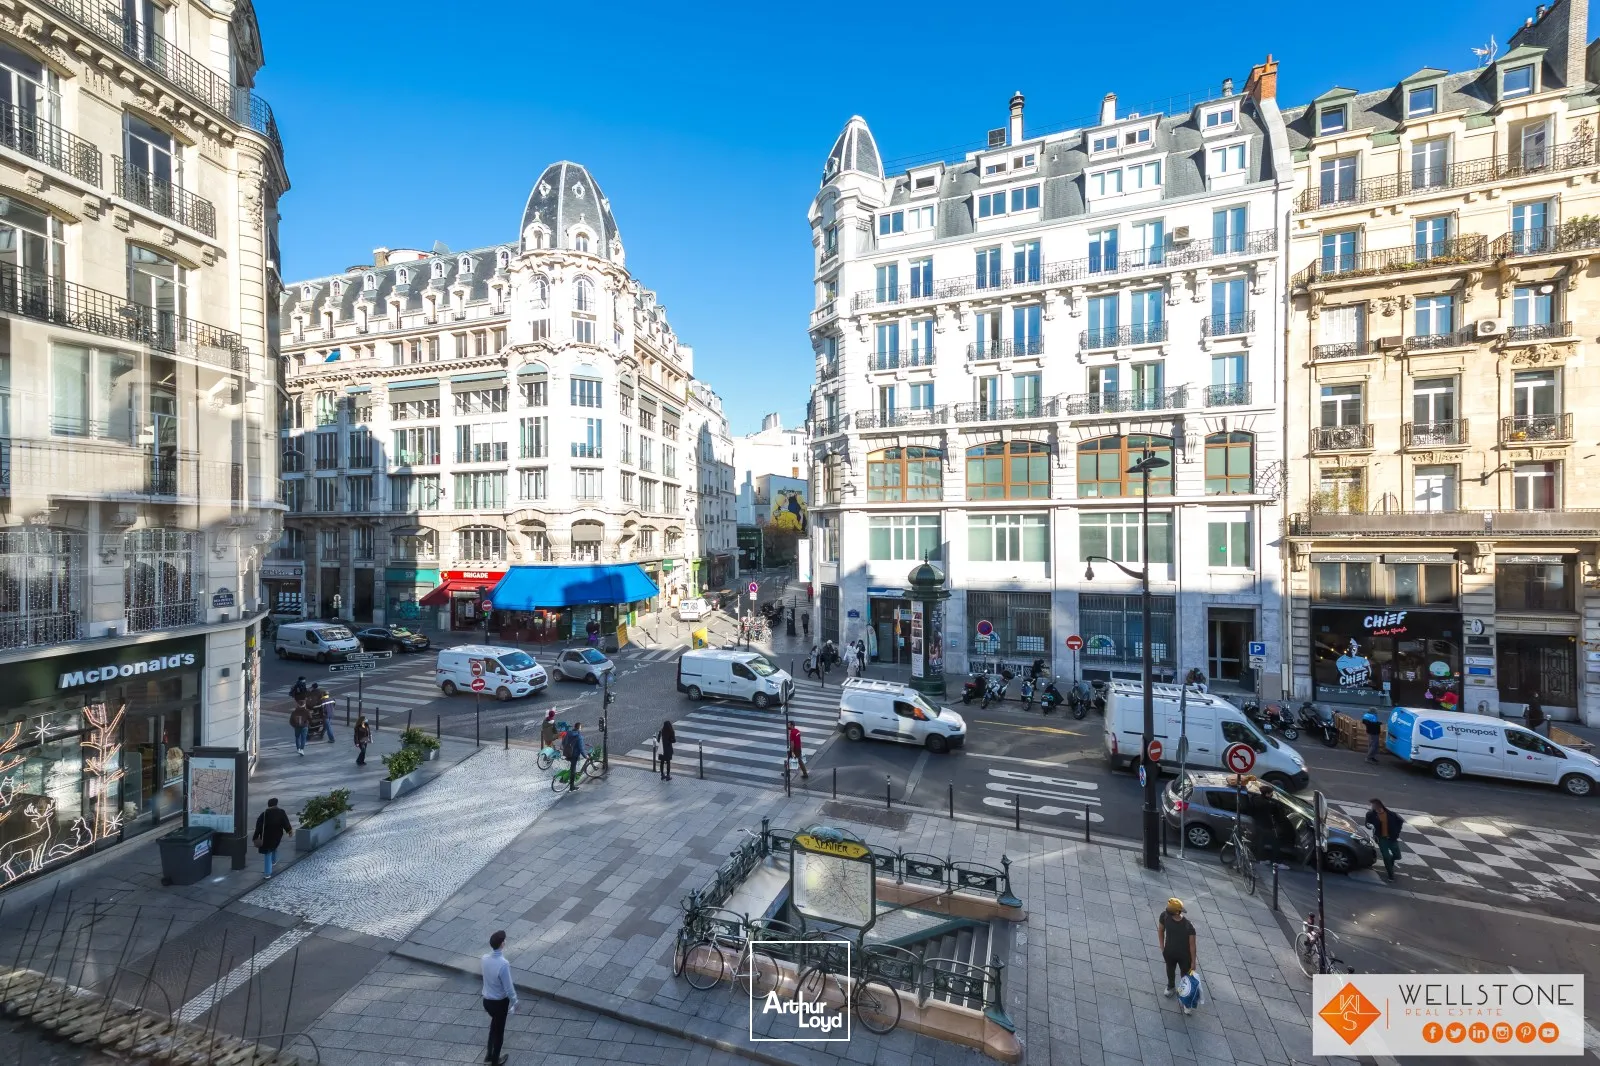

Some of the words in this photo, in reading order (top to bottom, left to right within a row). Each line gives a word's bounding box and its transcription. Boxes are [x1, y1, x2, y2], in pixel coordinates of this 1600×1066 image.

[463, 571, 488, 579] BRIGADE
[1254, 644, 1262, 653] P
[60, 653, 195, 688] McDonald's
[1446, 725, 1498, 737] chronopost
[814, 836, 849, 854] SENTIER
